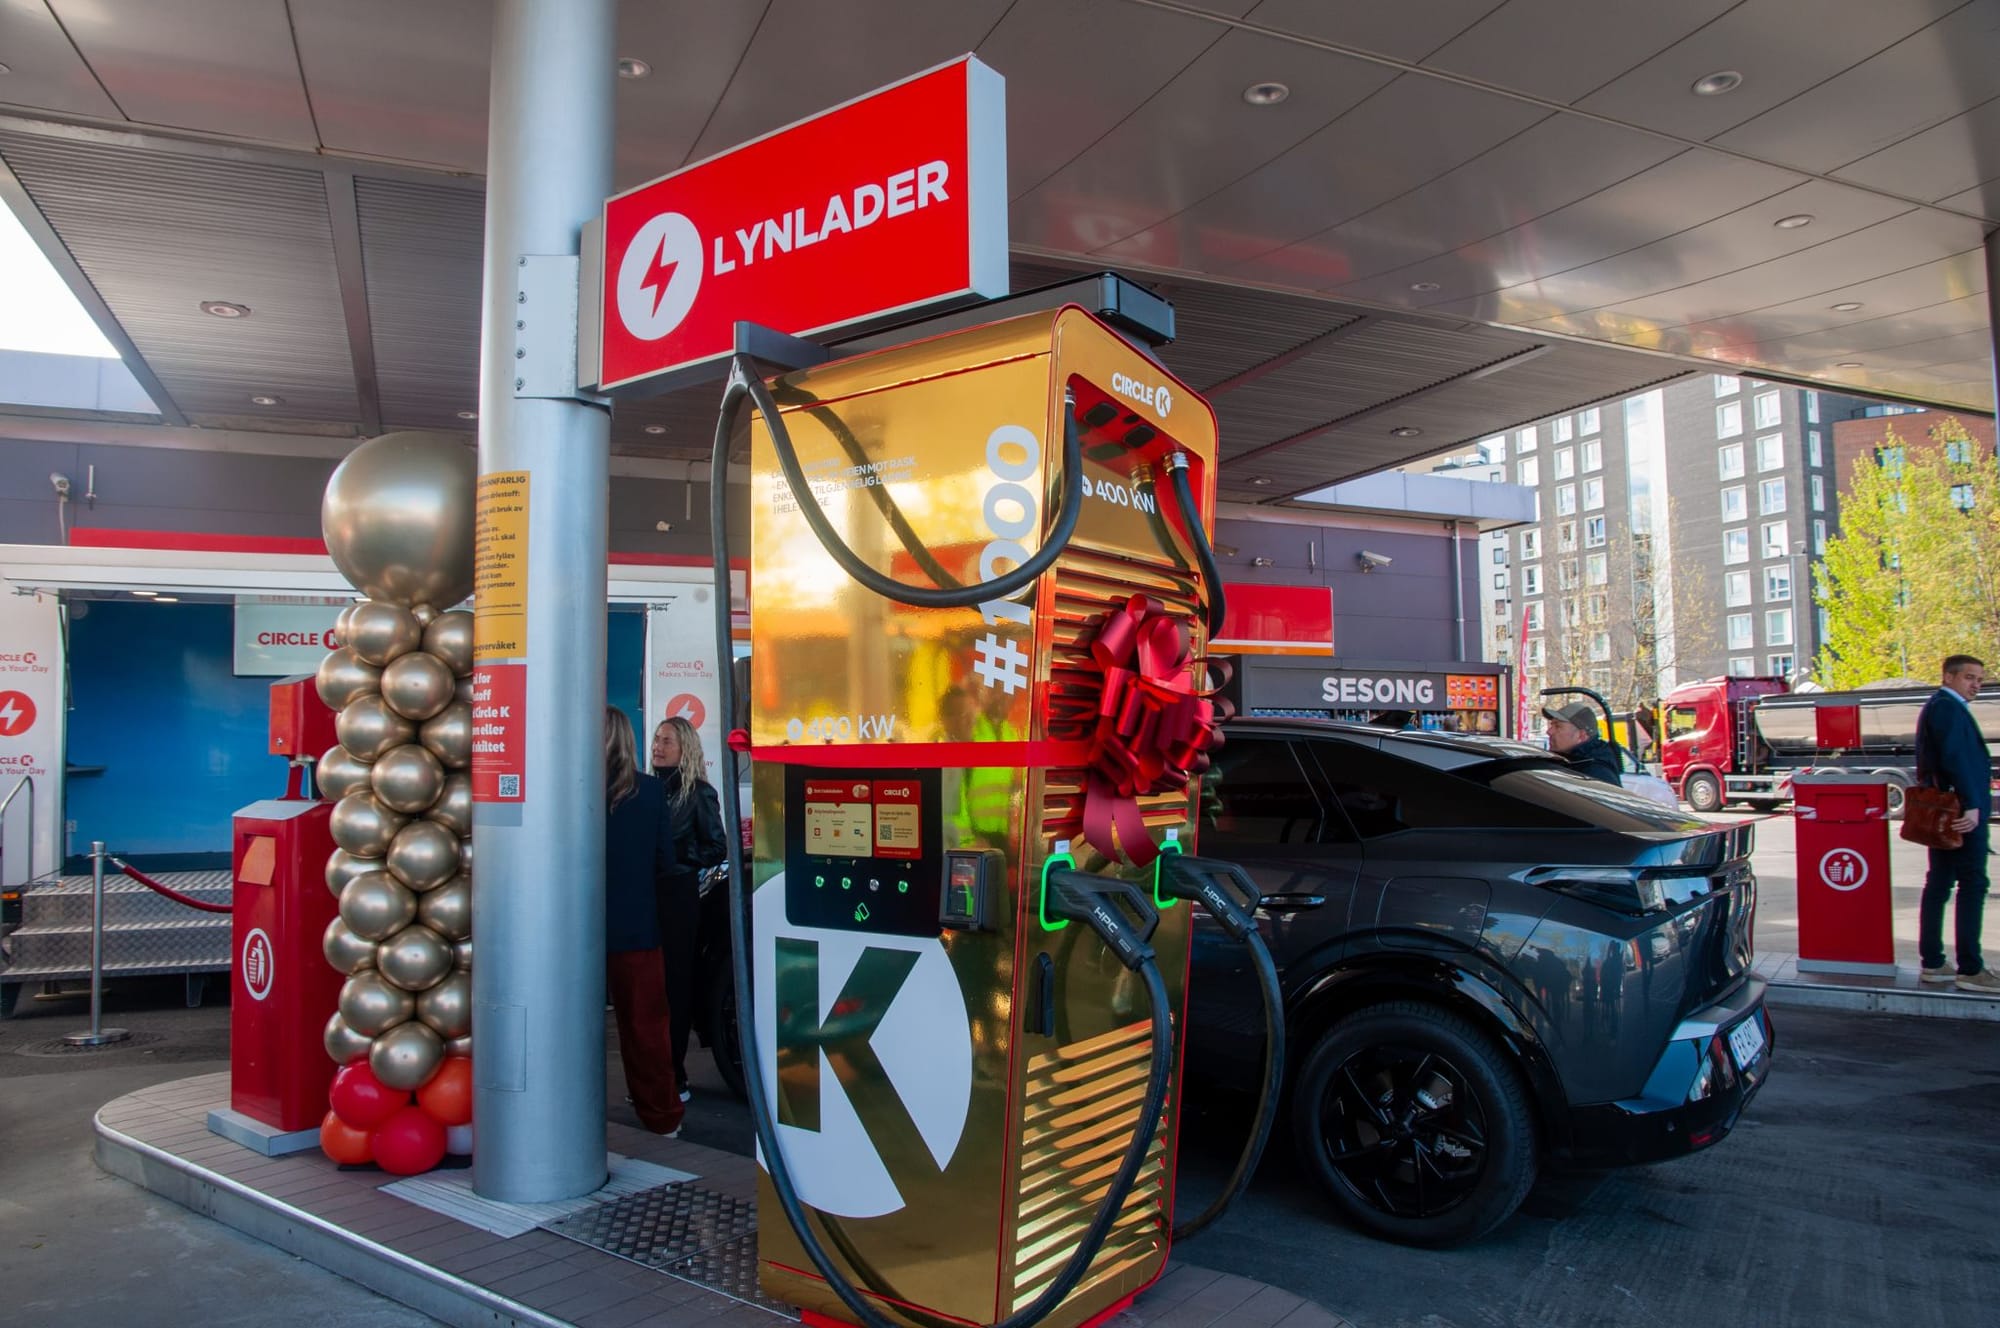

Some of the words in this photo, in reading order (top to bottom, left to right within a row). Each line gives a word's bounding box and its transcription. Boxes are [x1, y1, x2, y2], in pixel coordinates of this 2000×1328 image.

[713, 160, 950, 276] LYNLADER
[1112, 372, 1153, 406] CIRCLE
[1155, 386, 1172, 418] K
[868, 461, 888, 473] MOT
[497, 505, 513, 513] bruk
[1096, 479, 1128, 507] 400
[1130, 487, 1155, 514] kW
[501, 533, 516, 541] skal
[974, 424, 1040, 696] #1000
[258, 632, 318, 645] CIRCLE
[8, 665, 29, 673] Your
[32, 665, 48, 673] Day
[700, 671, 713, 679] Day
[1322, 677, 1434, 704] SESONG
[500, 706, 510, 718] K
[807, 717, 850, 740] 400
[858, 714, 896, 739] kW
[29, 768, 46, 776] Day
[1204, 885, 1227, 910] HPC
[1094, 906, 1119, 934] HPC
[756, 890, 965, 1214] K
